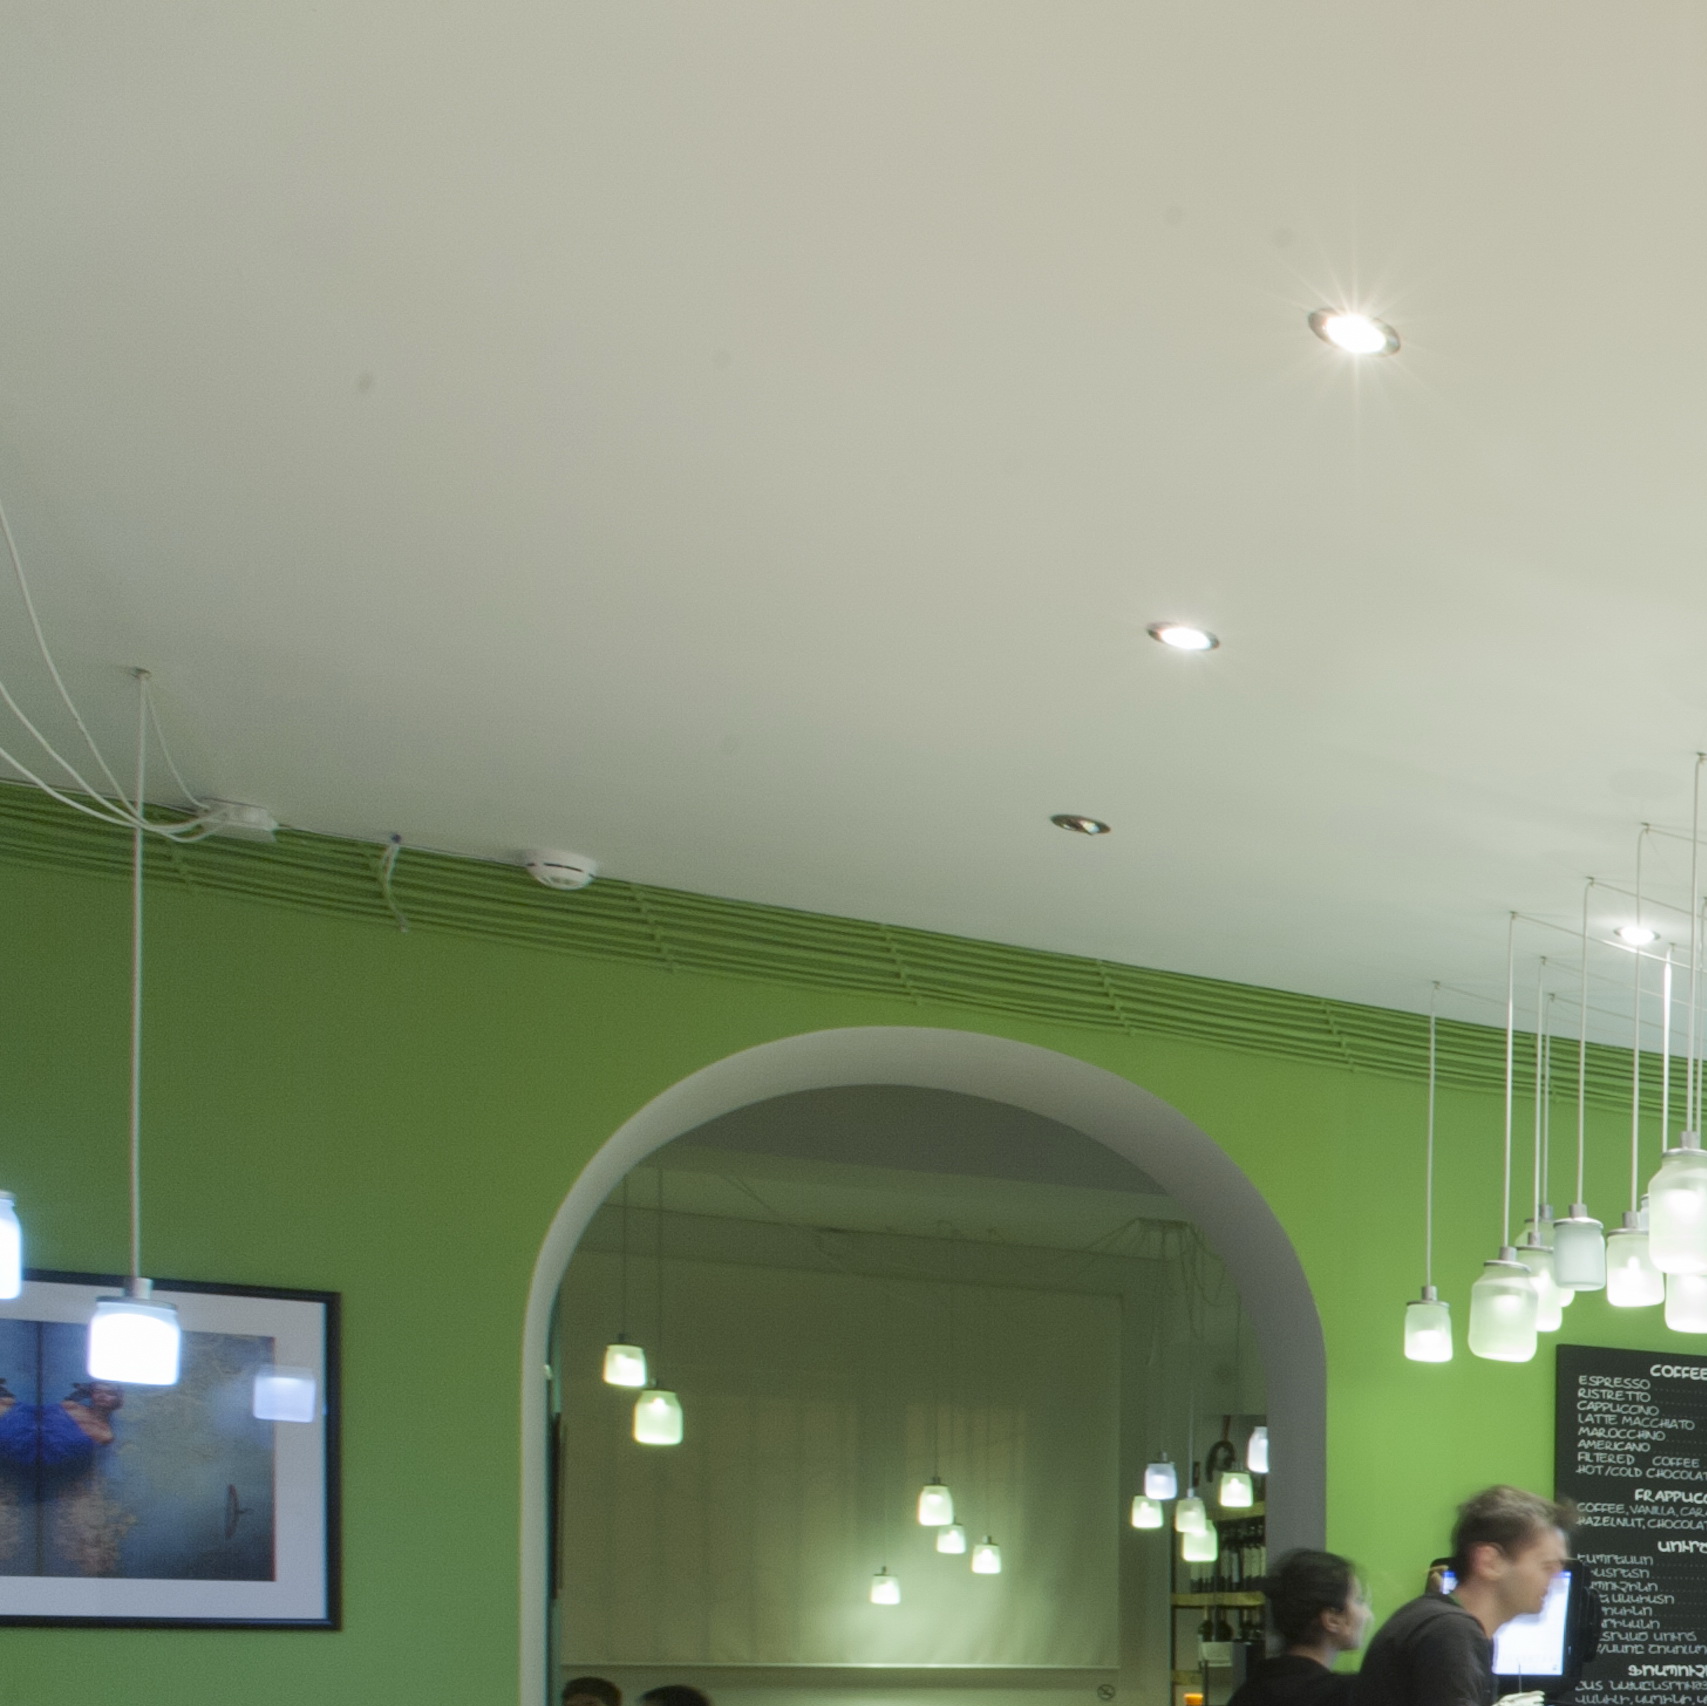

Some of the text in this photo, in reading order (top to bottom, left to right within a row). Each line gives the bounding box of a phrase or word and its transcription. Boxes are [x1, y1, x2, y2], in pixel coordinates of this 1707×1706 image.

[1578, 1375, 1651, 1390] ESPRESSO
[1577, 1389, 1651, 1402] RISTRETTO
[1577, 1413, 1618, 1425] LATTE
[1621, 1415, 1695, 1430] MACCHIATO
[1578, 1427, 1666, 1441] MAROCCHINO
[1577, 1439, 1650, 1452] AMERICANO
[1577, 1452, 1635, 1465] FILTERED
[1652, 1456, 1700, 1468] COFFEE
[1575, 1464, 1603, 1476] HOT
[1577, 1502, 1629, 1515] COFFEE,
